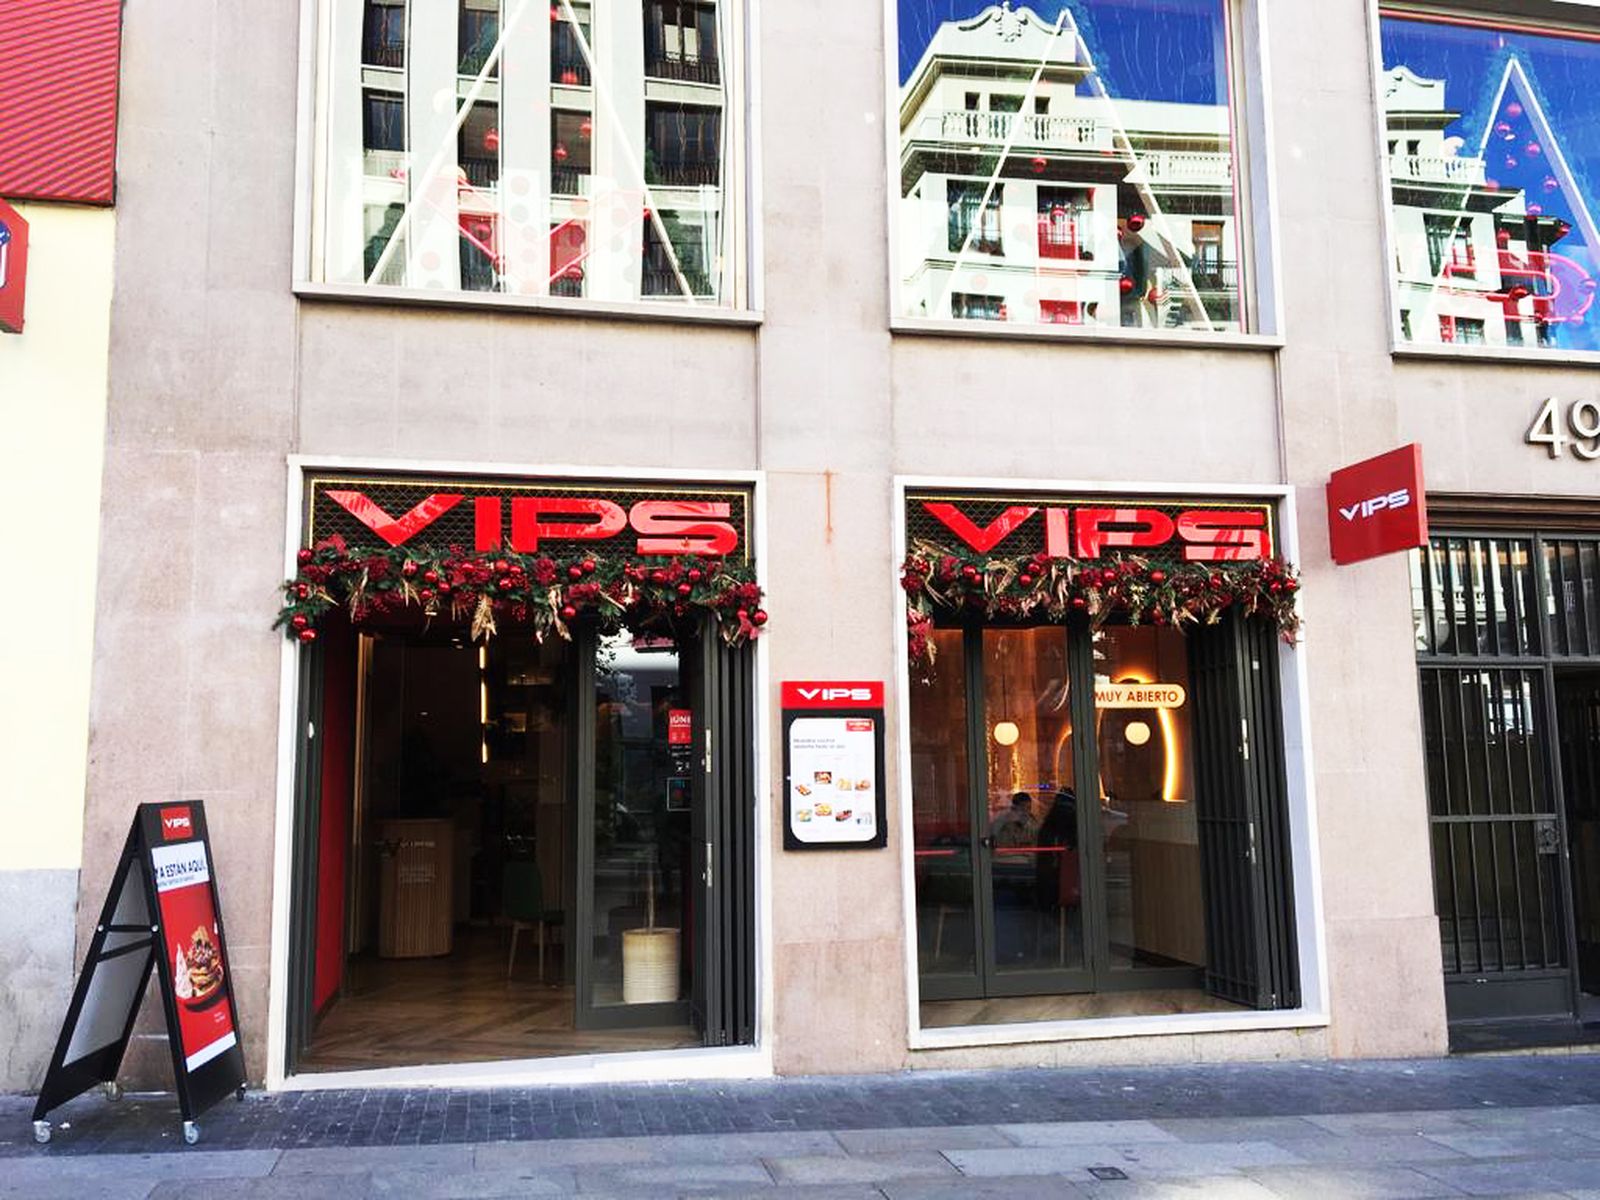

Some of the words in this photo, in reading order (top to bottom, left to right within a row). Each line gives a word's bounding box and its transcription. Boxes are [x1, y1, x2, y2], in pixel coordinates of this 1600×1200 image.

[1525, 398, 1600, 461] 49
[1339, 489, 1410, 521] VIPS
[324, 490, 739, 556] VIPS
[922, 503, 1273, 560] VIPS
[797, 688, 872, 701] VIPS
[1127, 690, 1179, 702] ABIERTO
[165, 818, 190, 828] VIPS
